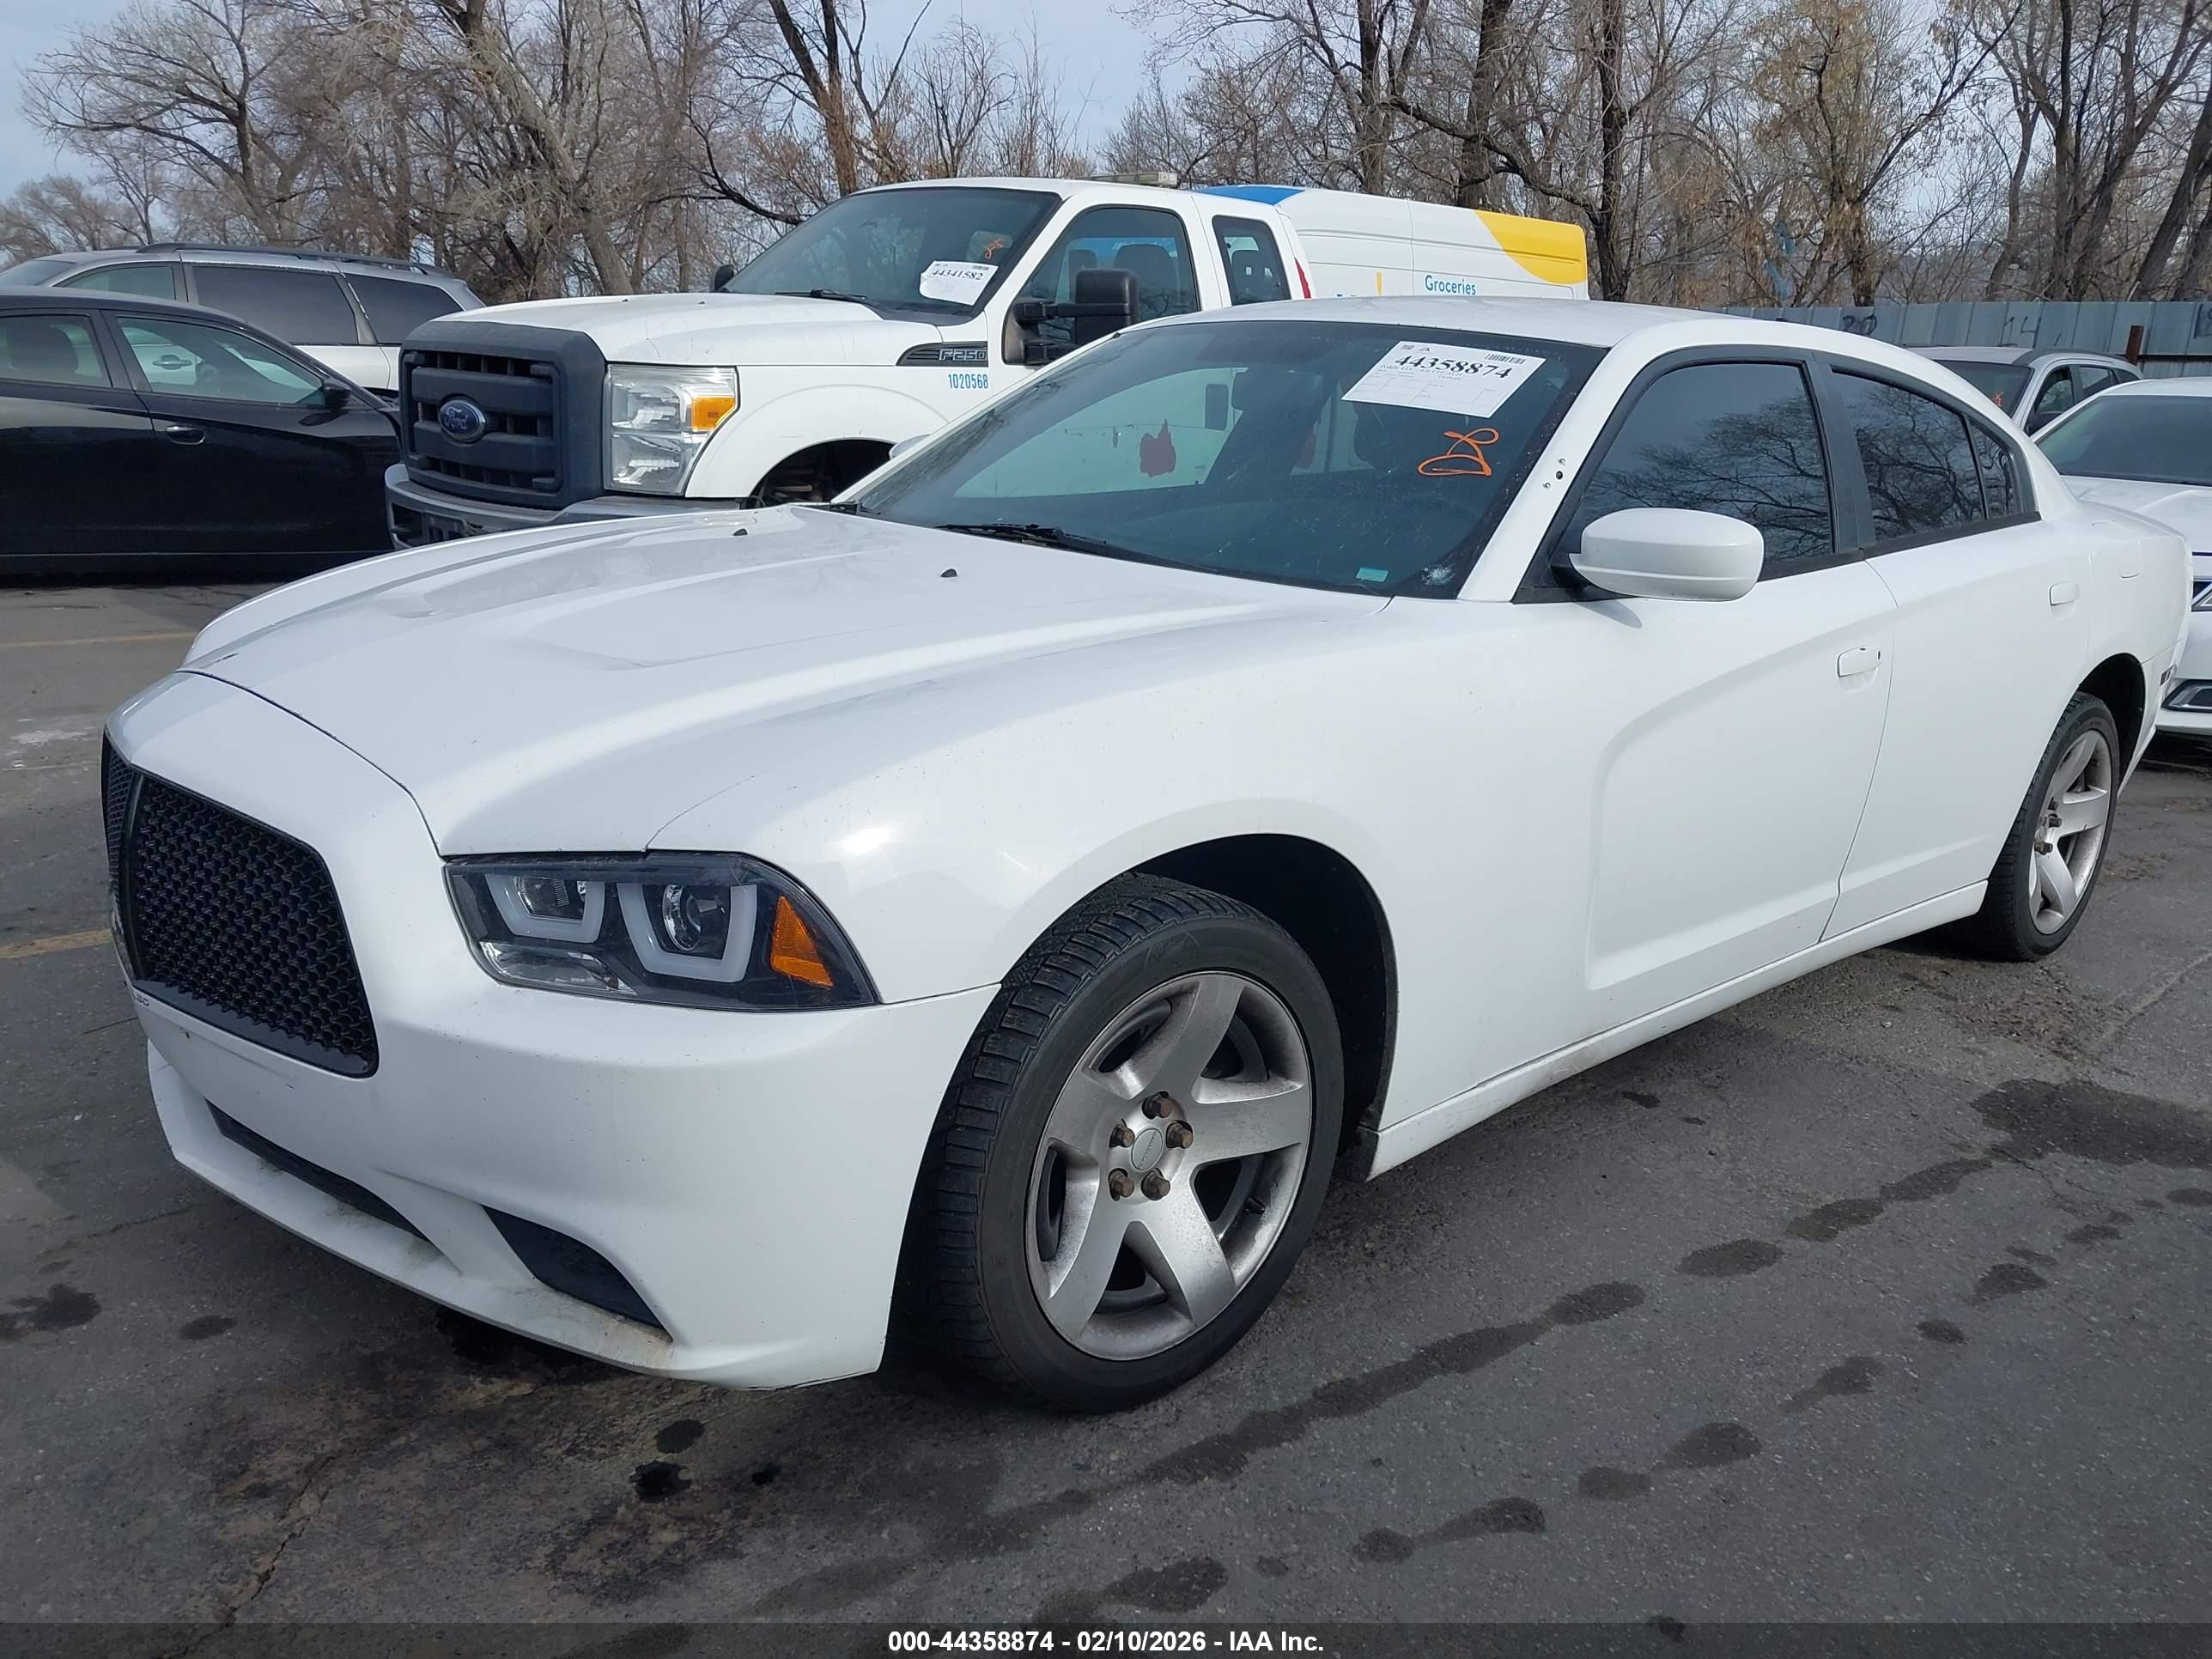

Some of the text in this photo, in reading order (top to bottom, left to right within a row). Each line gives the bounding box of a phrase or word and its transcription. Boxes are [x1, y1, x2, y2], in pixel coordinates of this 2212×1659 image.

[932, 269, 983, 281] 44341582
[1424, 274, 1477, 296] Groceries
[1395, 354, 1514, 380] 44358874
[947, 373, 989, 391] 1020568
[445, 406, 469, 430] Ford
